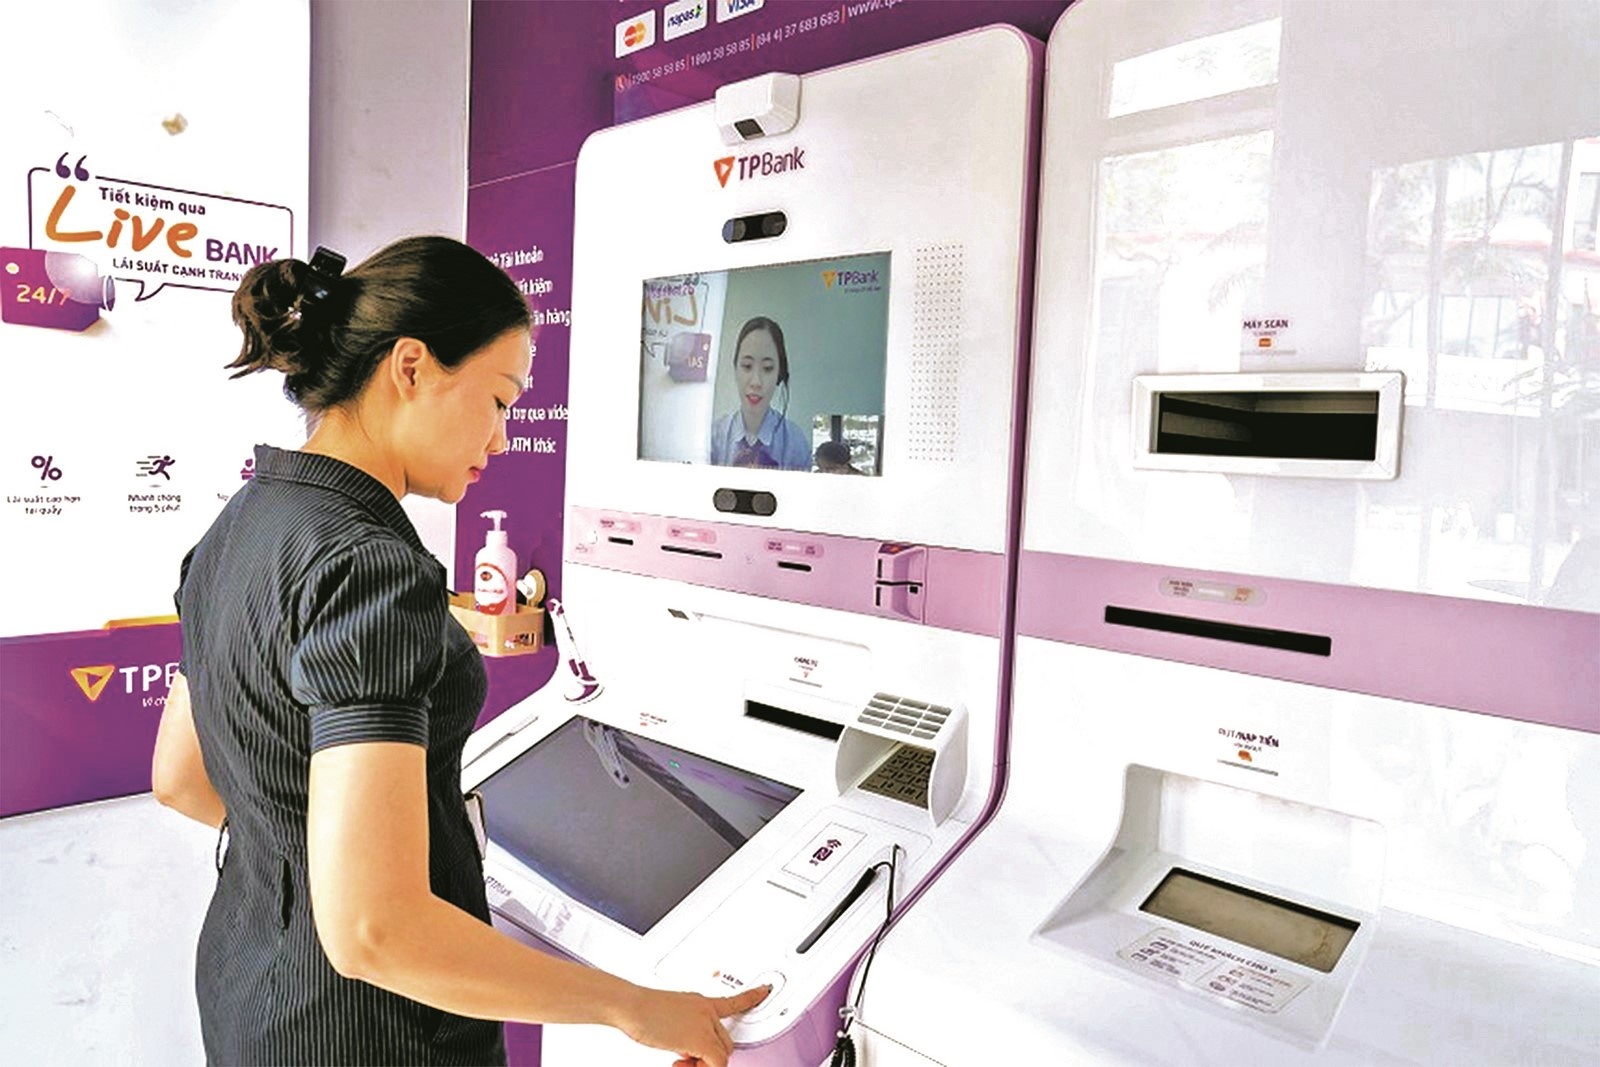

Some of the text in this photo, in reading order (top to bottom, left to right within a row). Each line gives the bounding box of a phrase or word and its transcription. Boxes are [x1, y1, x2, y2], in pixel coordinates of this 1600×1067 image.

[738, 146, 805, 181] TPBank
[99, 186, 206, 215] Tiết kiệm qua
[45, 185, 278, 267] Live BANK
[172, 264, 206, 279] CẠNH
[208, 269, 242, 283] TRAN
[837, 269, 879, 286] TPBank
[1264, 318, 1289, 329] SCAN
[511, 436, 532, 452] ATM
[118, 661, 181, 694] TPB
